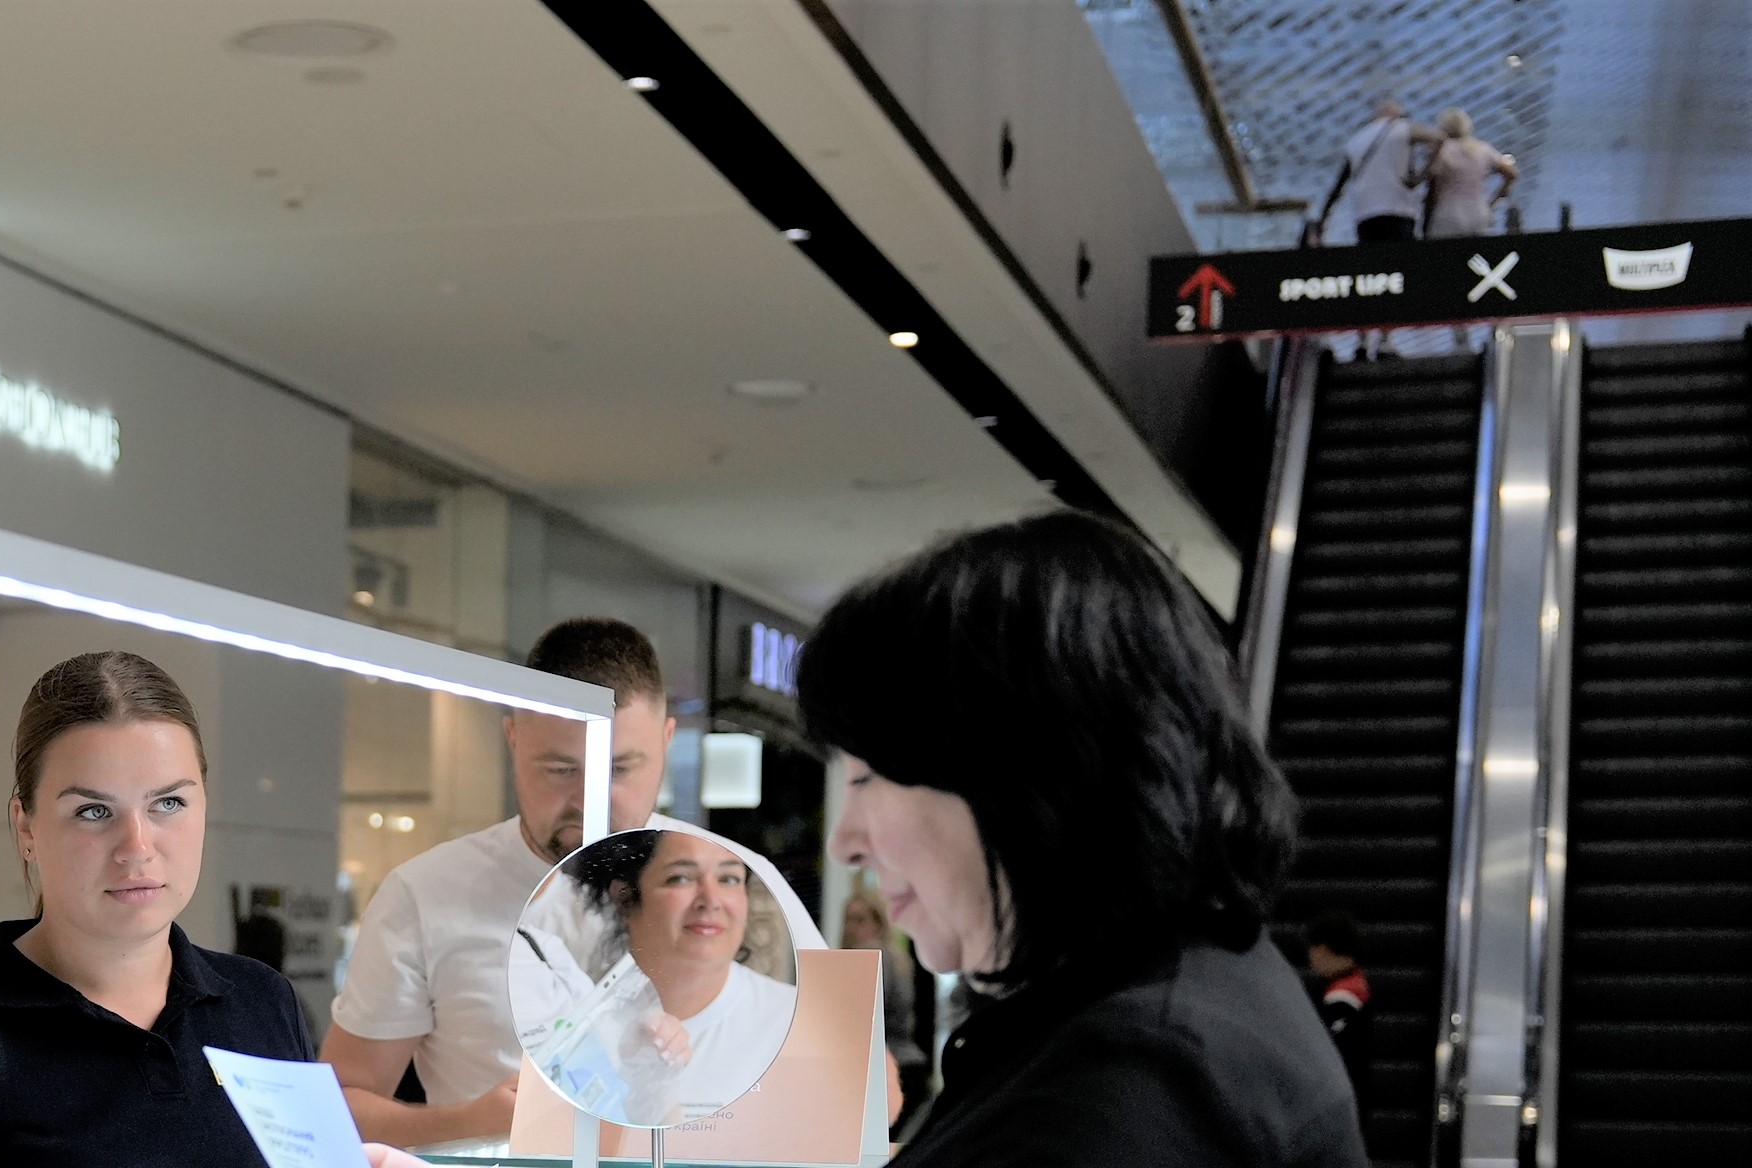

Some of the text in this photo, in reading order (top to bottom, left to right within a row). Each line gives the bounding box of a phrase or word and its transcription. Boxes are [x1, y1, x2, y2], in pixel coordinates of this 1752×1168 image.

[1279, 272, 1405, 302] SPORT LIFE
[1175, 304, 1196, 332] 2
[665, 1121, 717, 1132] країні
